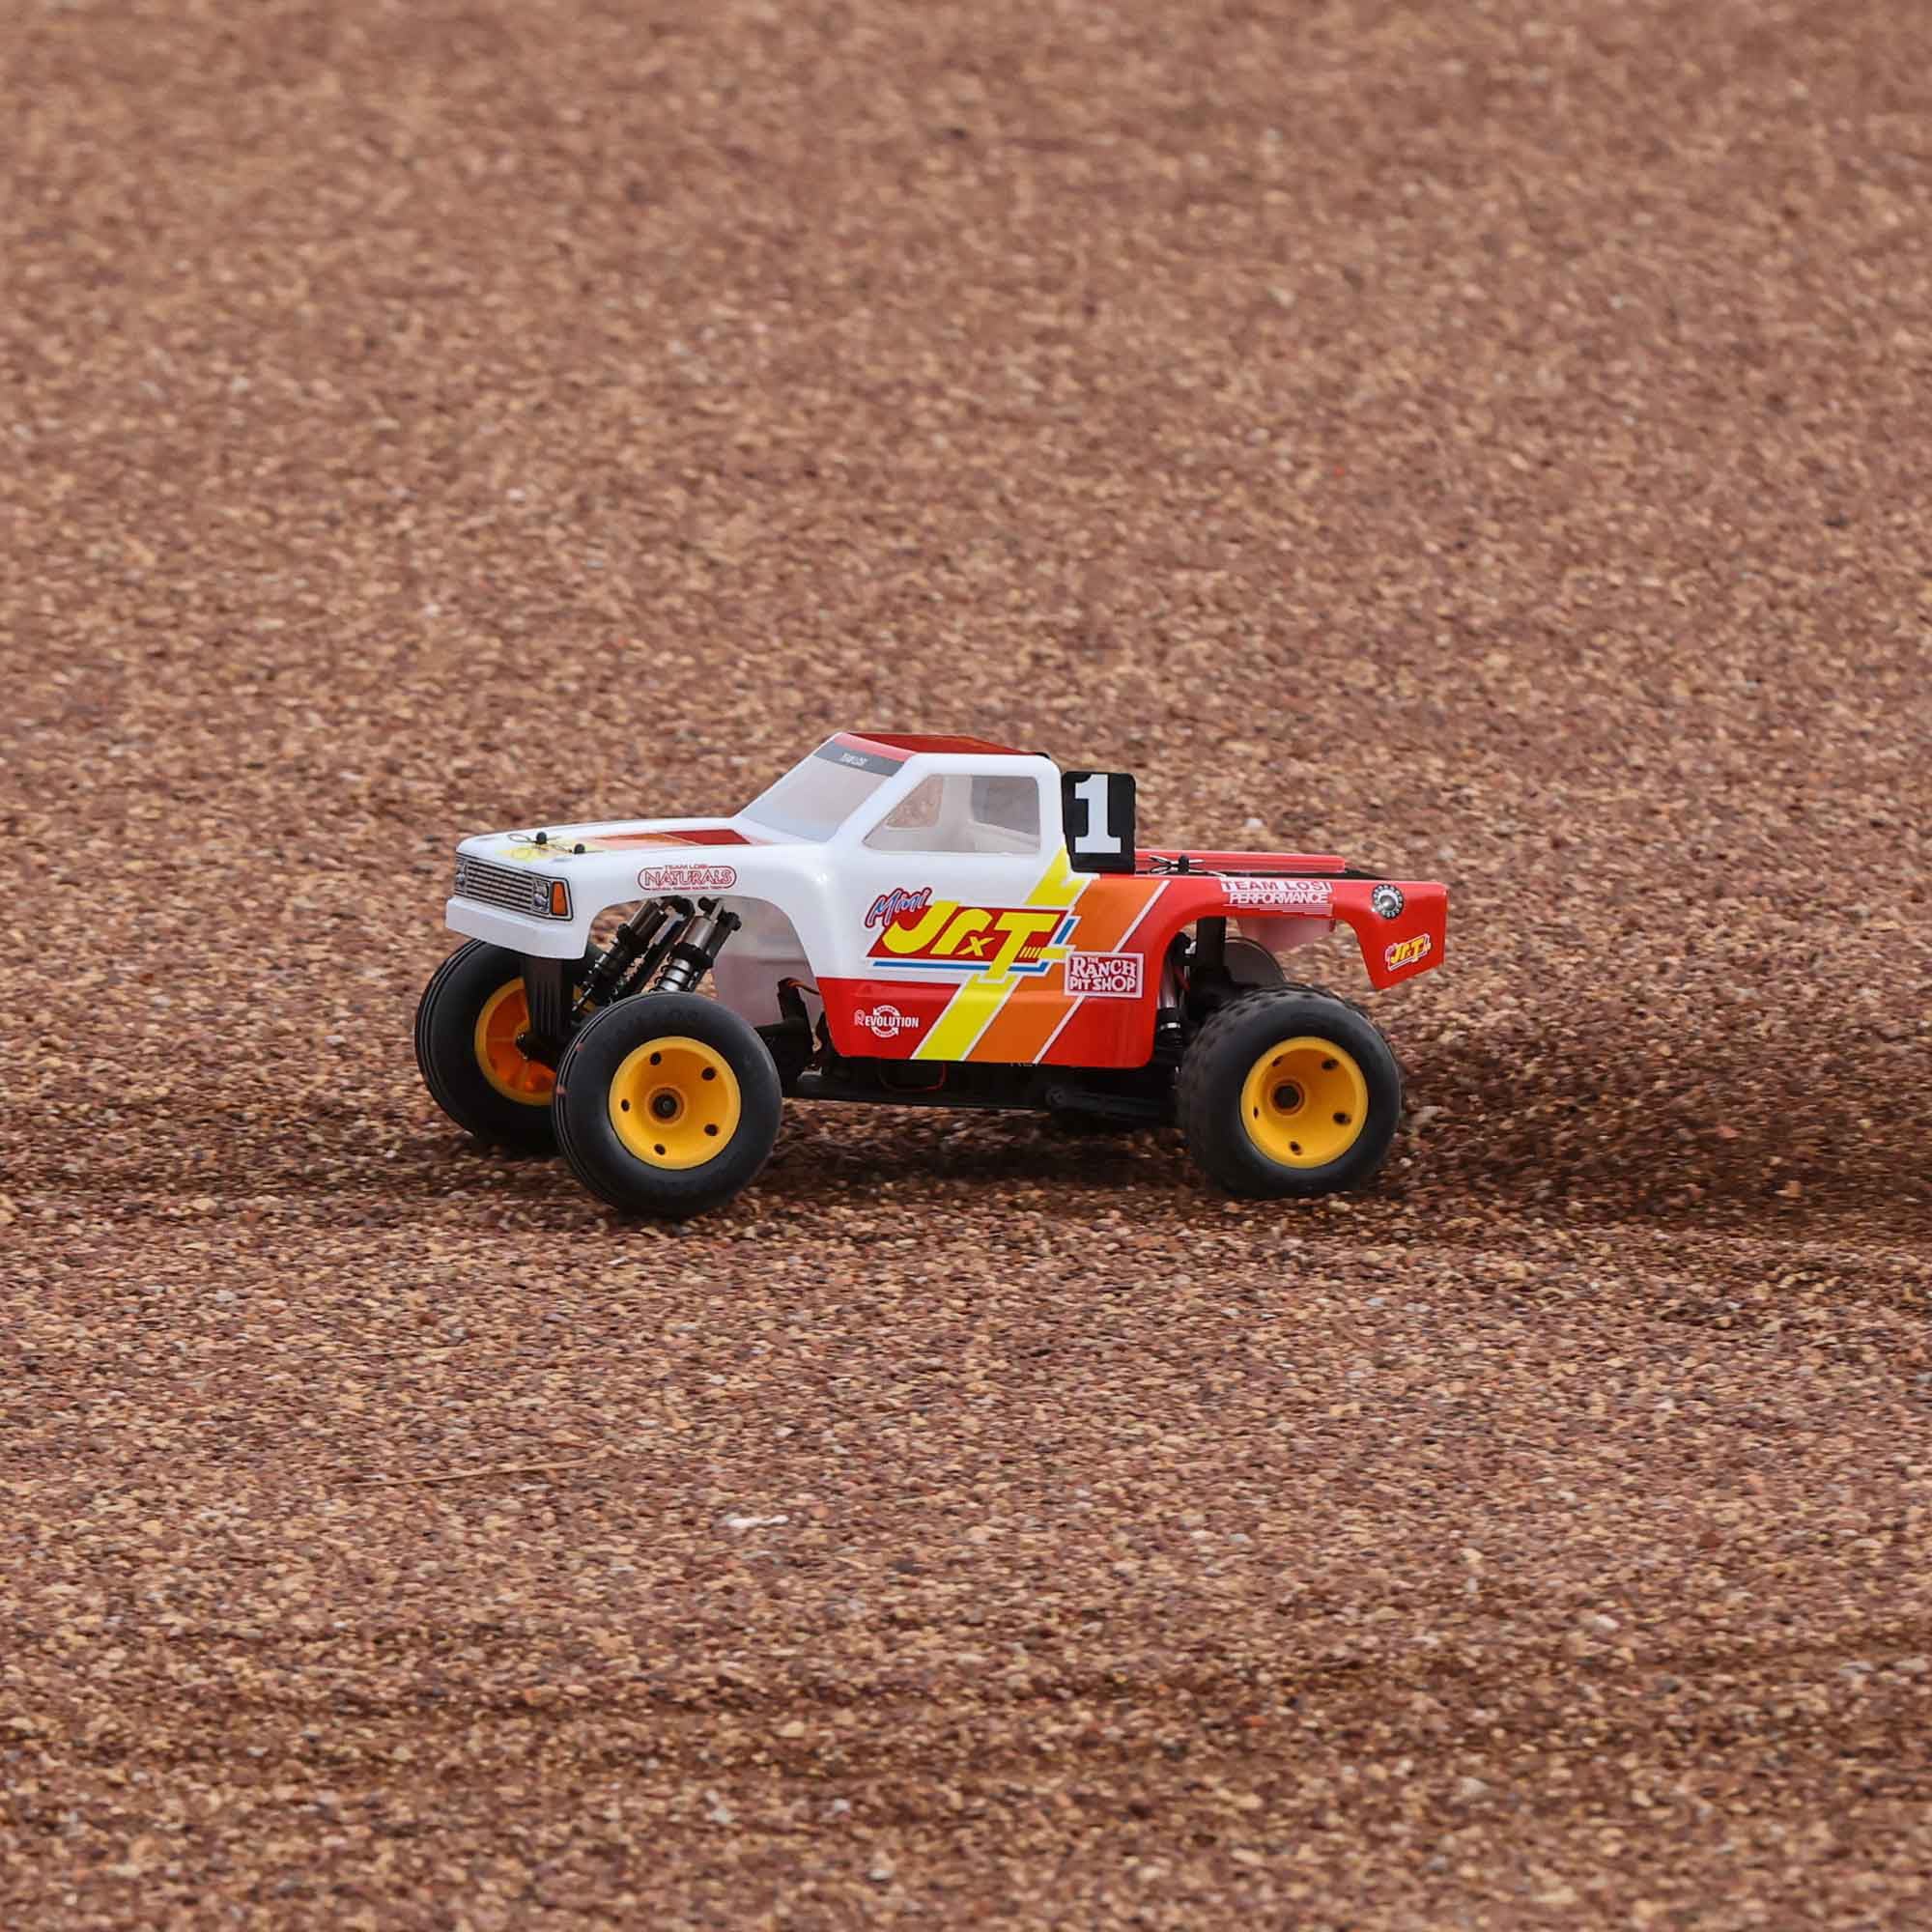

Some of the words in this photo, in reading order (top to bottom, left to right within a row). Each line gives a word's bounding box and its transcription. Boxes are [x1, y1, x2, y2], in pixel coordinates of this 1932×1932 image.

[1075, 774, 1122, 854] 1
[644, 869, 732, 886] NATURALS
[1222, 880, 1278, 891] TEAM
[1282, 880, 1332, 891] LOSI
[1229, 891, 1329, 904] PERFORMANCE
[866, 887, 932, 927] Mini
[1070, 956, 1137, 979] RANCH
[1069, 976, 1092, 990] PIT
[1093, 975, 1136, 992] SHOP
[854, 1009, 920, 1028] REVOLUTION
